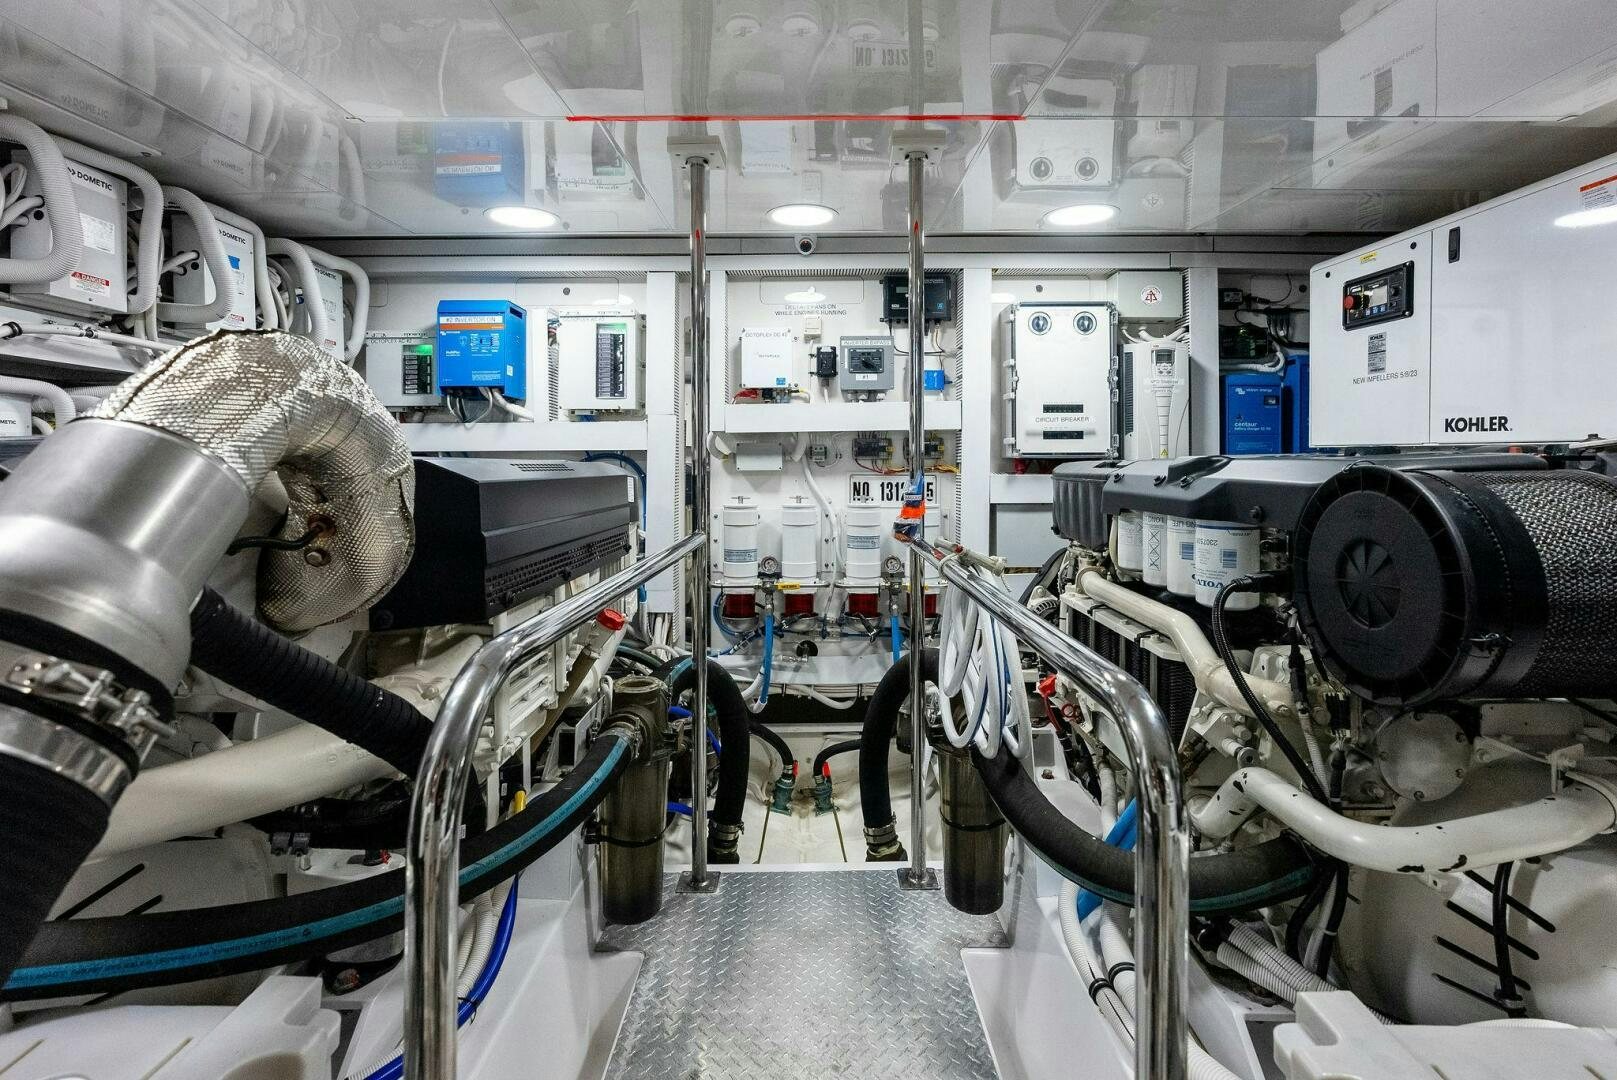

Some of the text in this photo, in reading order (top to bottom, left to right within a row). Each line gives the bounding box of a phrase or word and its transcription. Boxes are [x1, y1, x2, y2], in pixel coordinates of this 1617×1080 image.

[77, 170, 112, 191] DOMETIC
[222, 230, 246, 245] DOMETIC
[319, 269, 337, 280] DOMETIC
[1352, 376, 1366, 385] NEW
[1367, 372, 1399, 383] IMPELLERS
[1444, 416, 1510, 433] KOHLER
[852, 481, 874, 501] NO.
